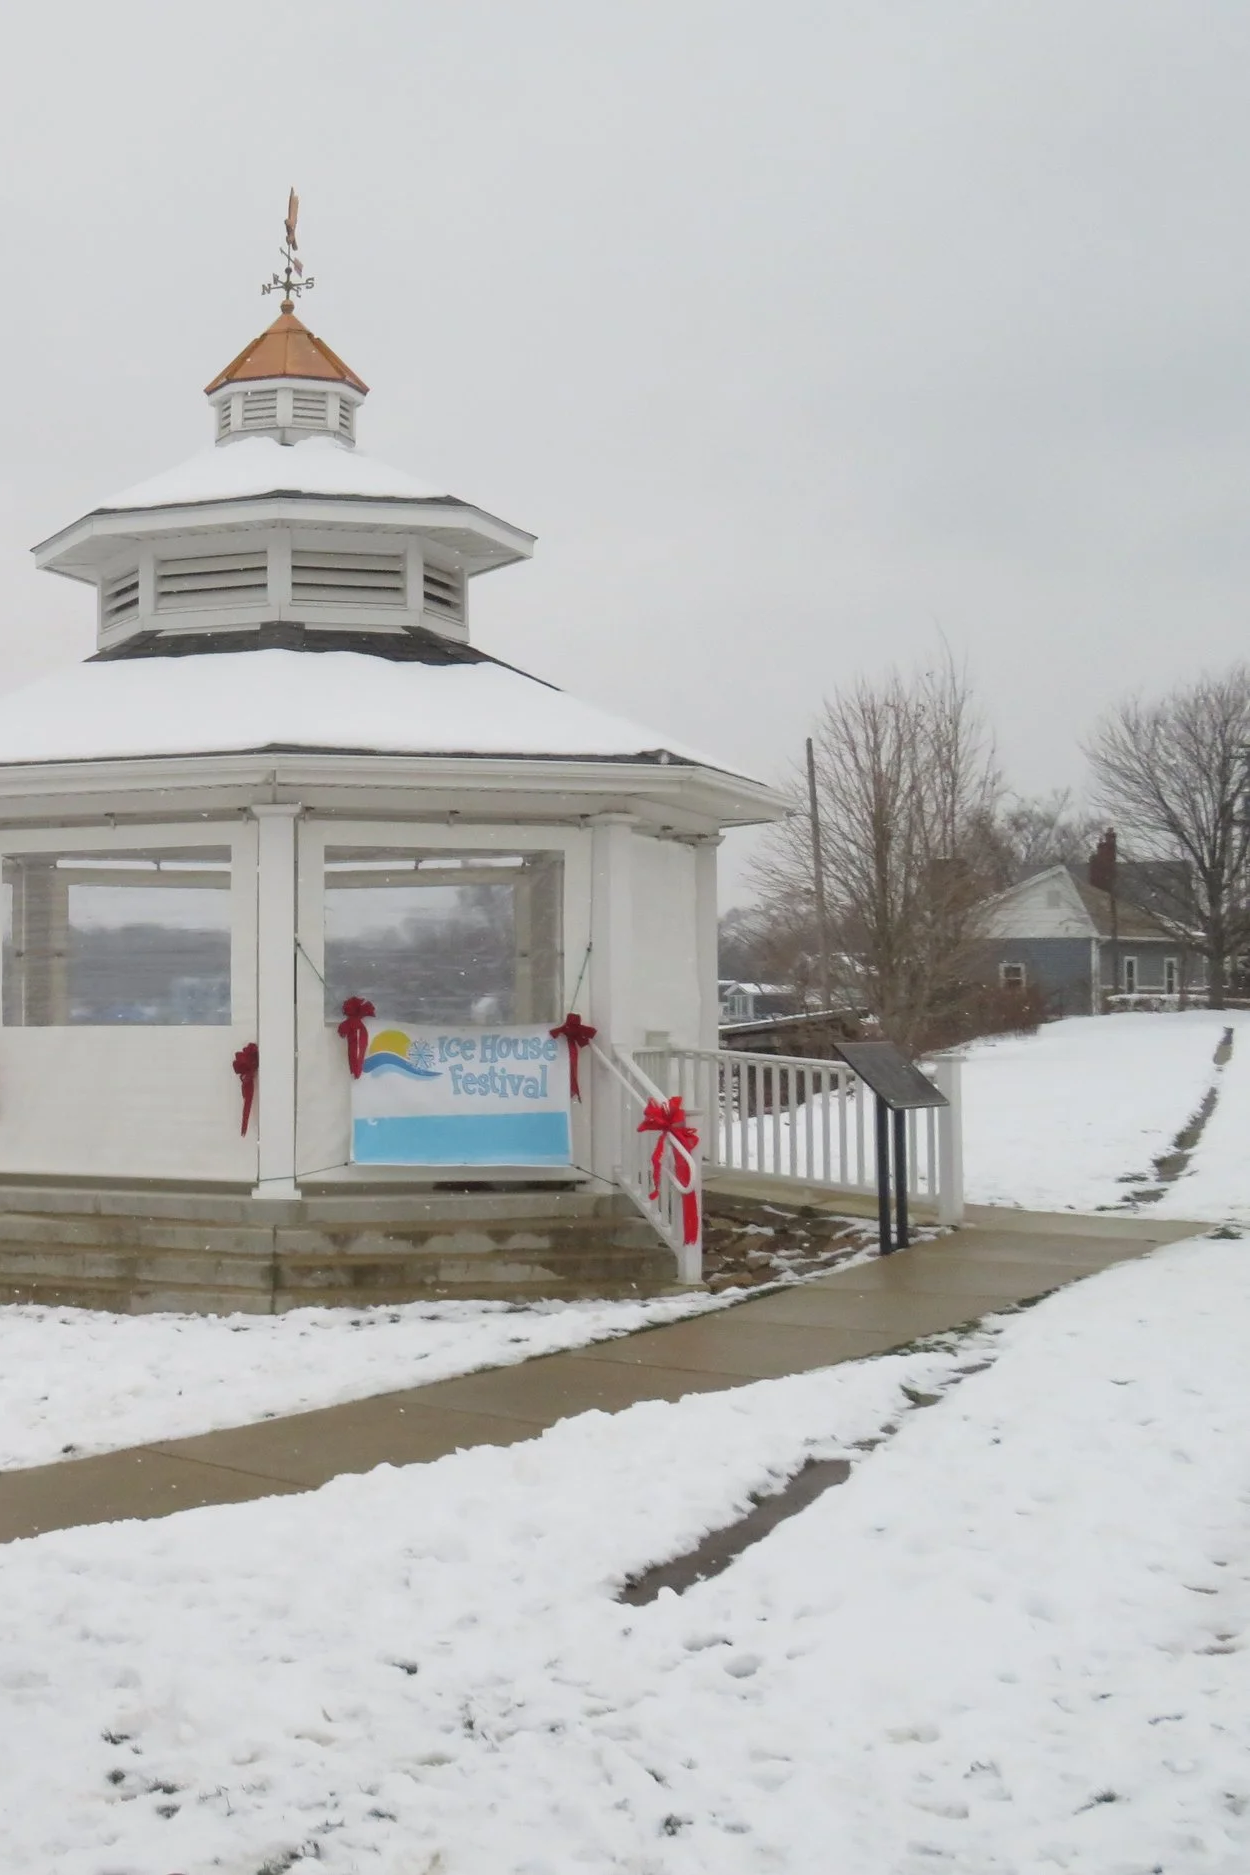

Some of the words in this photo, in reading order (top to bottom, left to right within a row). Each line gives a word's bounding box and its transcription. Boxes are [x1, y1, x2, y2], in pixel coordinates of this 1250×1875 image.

[261, 283, 272, 295] N
[305, 277, 315, 289] S
[437, 1036, 477, 1062] Ice
[480, 1034, 558, 1063] House
[448, 1064, 548, 1099] Festival
